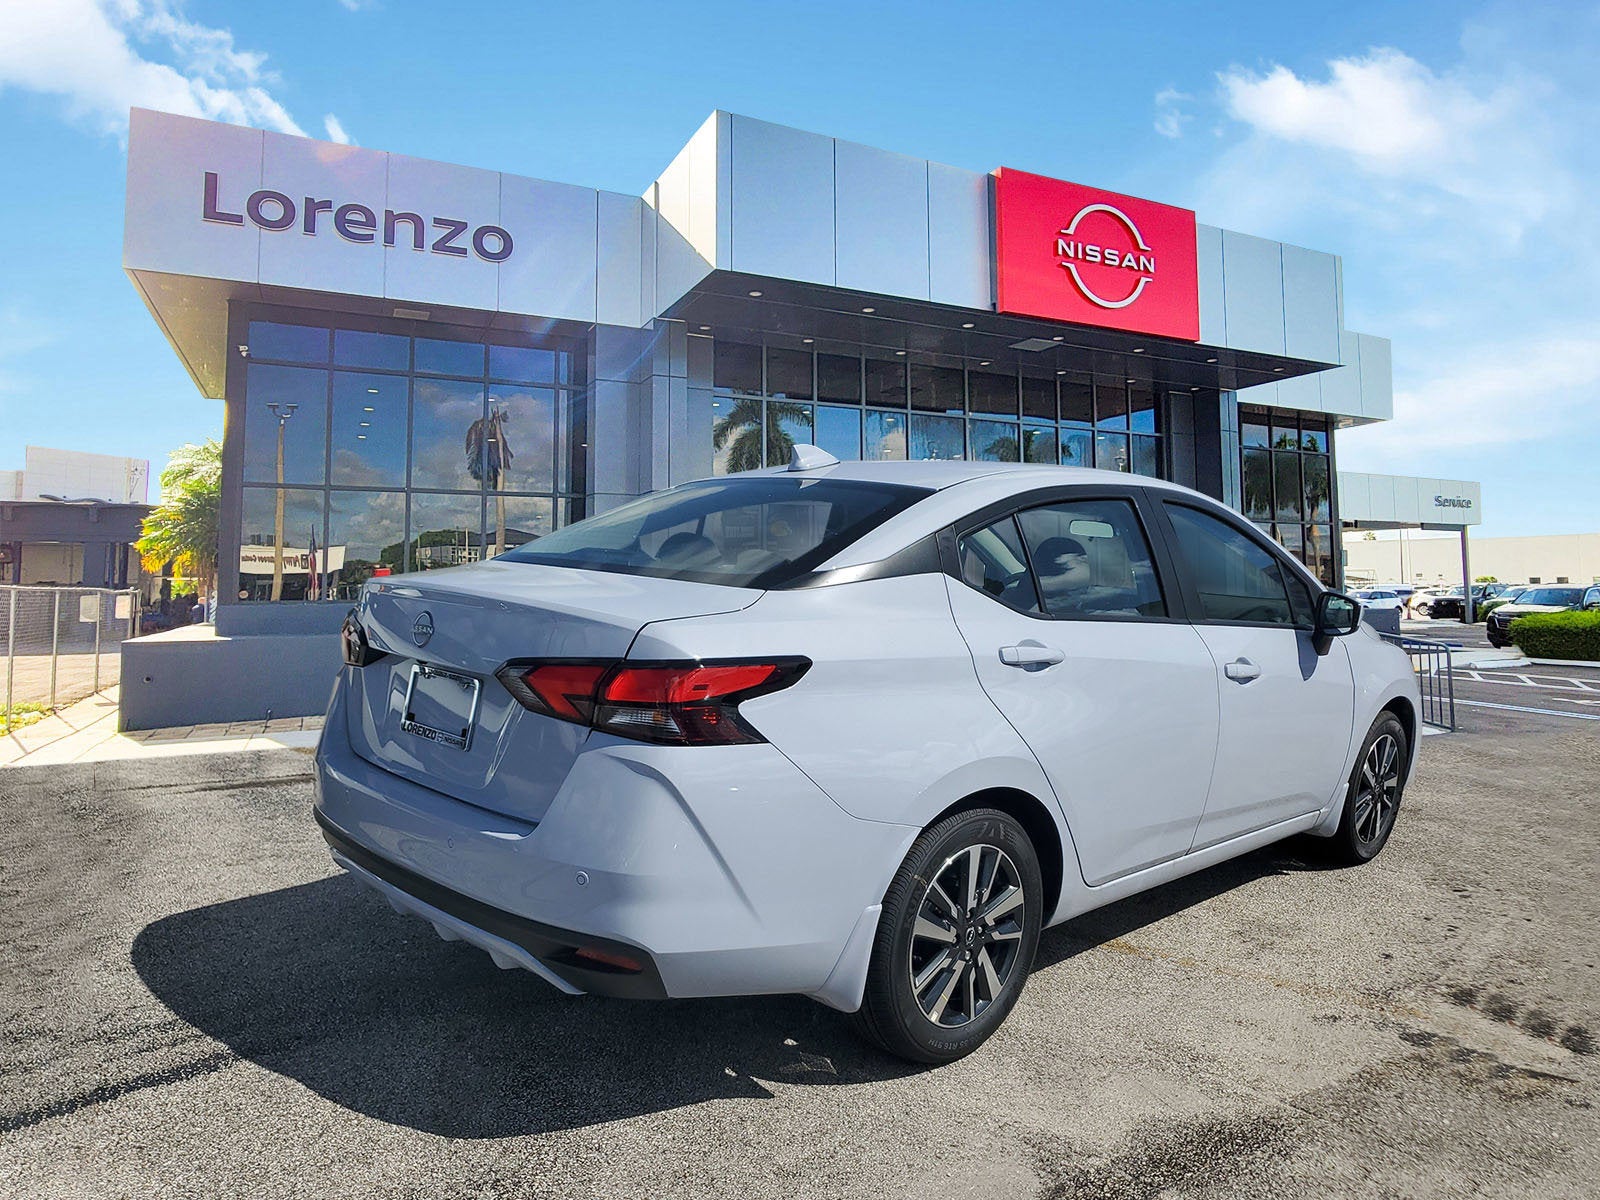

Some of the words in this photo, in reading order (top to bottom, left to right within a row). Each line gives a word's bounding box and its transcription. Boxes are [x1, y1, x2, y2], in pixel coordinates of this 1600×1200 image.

[203, 171, 514, 262] Lorenzo
[1057, 238, 1155, 273] NISSAN
[1434, 495, 1472, 508] Service
[402, 721, 436, 740] LORENZO
